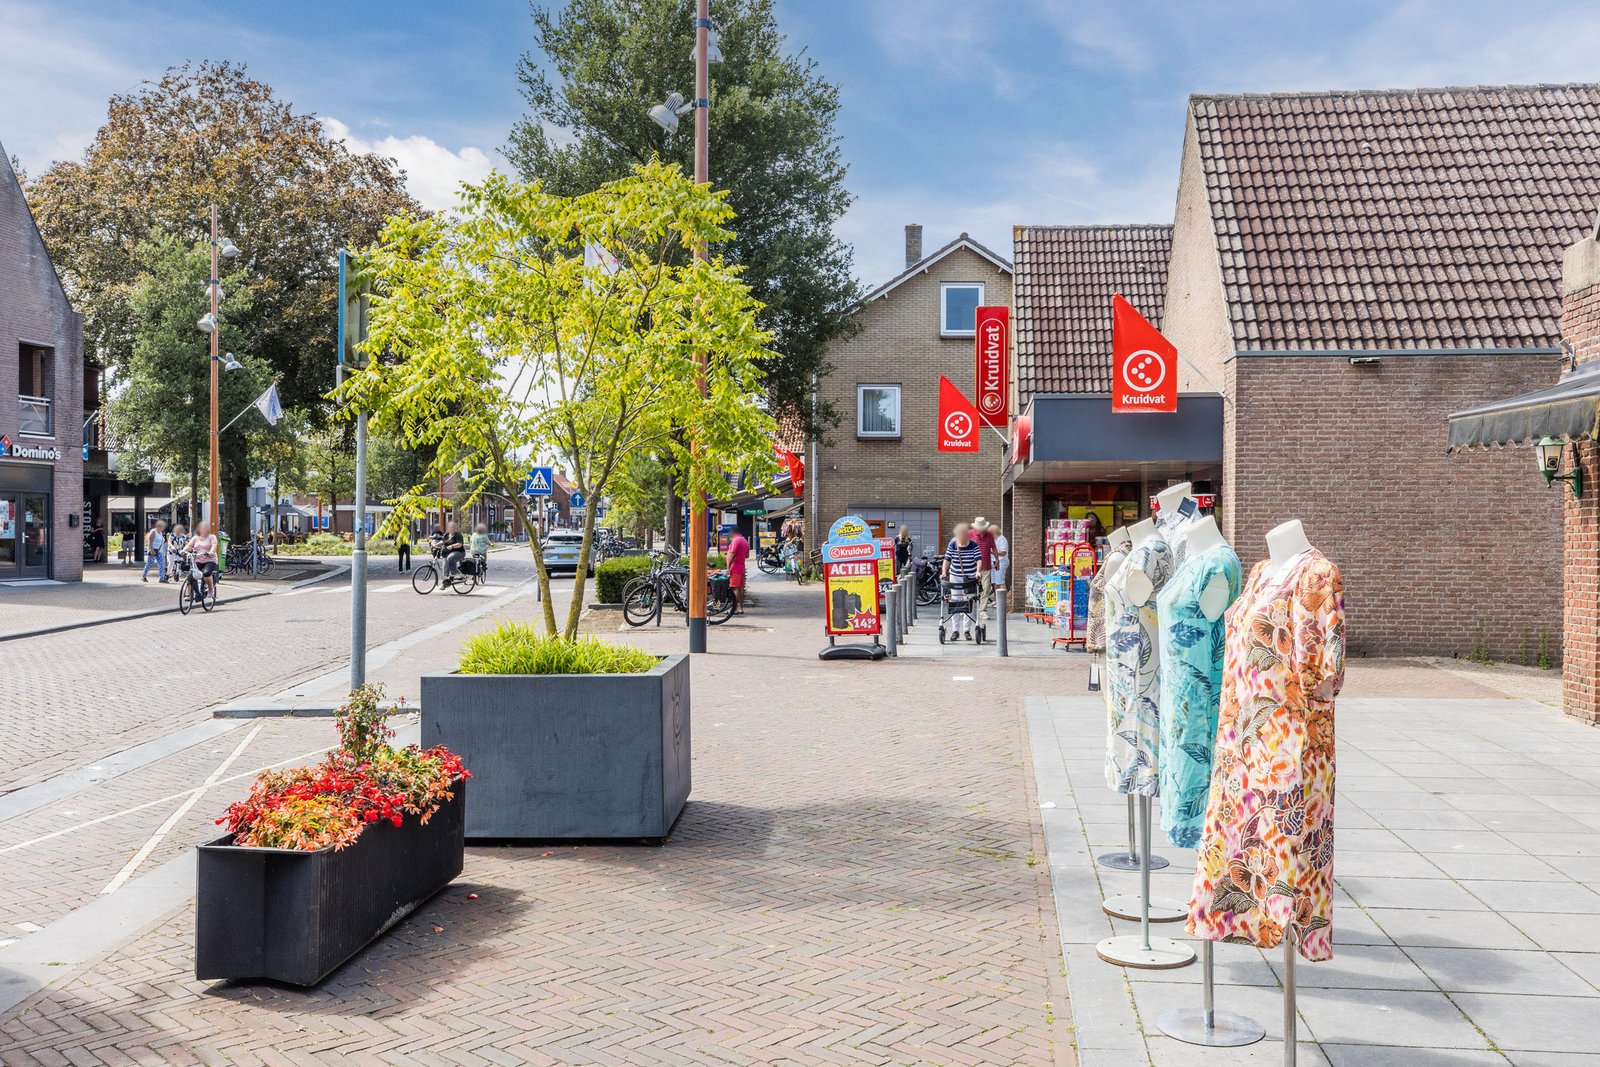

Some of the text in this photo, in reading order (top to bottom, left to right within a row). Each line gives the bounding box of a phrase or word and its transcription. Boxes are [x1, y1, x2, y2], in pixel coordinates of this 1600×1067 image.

[984, 325, 1000, 391] Kruidvat
[1122, 394, 1166, 405] Kruidvat
[943, 439, 972, 447] Kruidvat
[12, 444, 62, 460] Domino's
[840, 546, 872, 556] Kruidvat
[831, 563, 872, 575] ACTIE!
